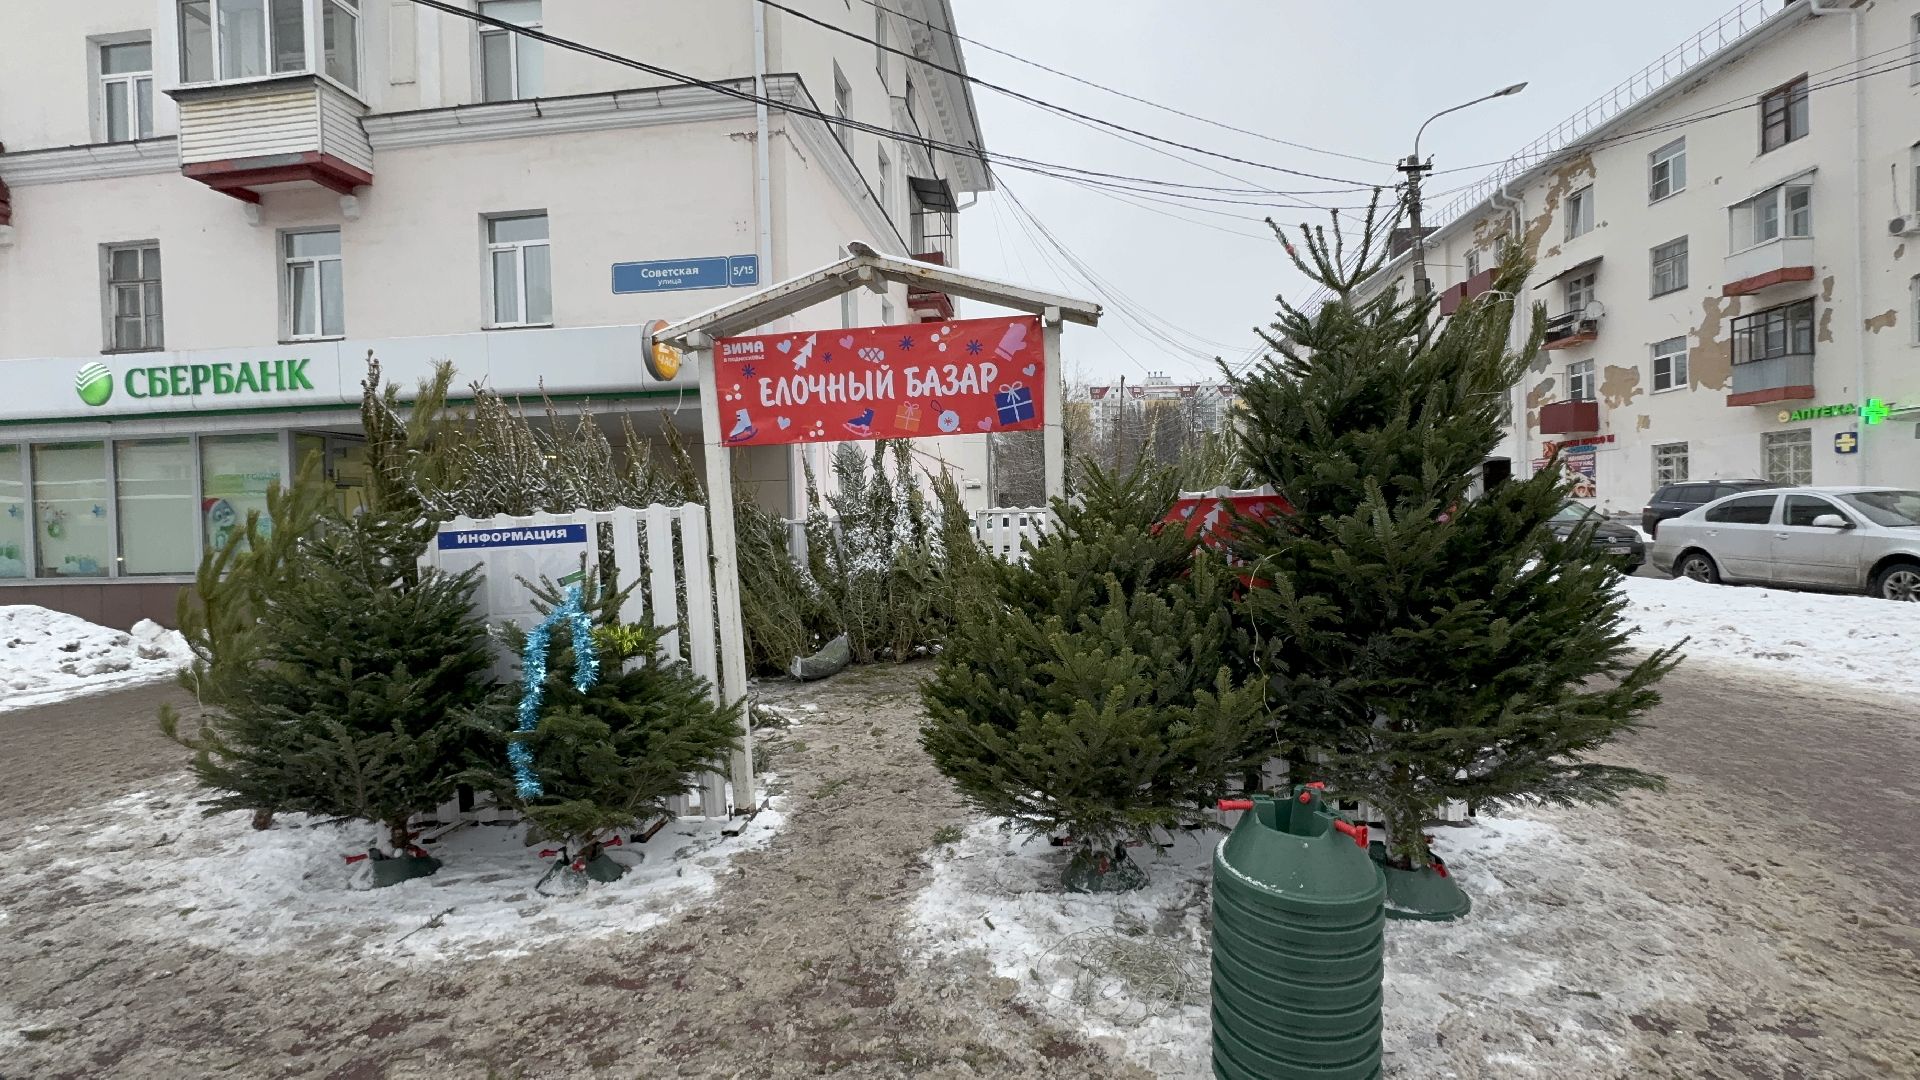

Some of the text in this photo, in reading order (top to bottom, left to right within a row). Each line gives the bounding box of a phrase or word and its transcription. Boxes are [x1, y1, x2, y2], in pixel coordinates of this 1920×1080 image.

[641, 266, 699, 279] Советская
[733, 265, 754, 277] 5/15
[657, 277, 682, 287] улица
[723, 341, 764, 356] ЗИМА
[125, 358, 314, 398] СБЕРБАНК
[759, 361, 999, 408] ЕЛОЧНЫЙ БАЗАР
[1790, 402, 1856, 422] АПТЕКА
[457, 529, 567, 544] ИНФОРМАЦИЯ
